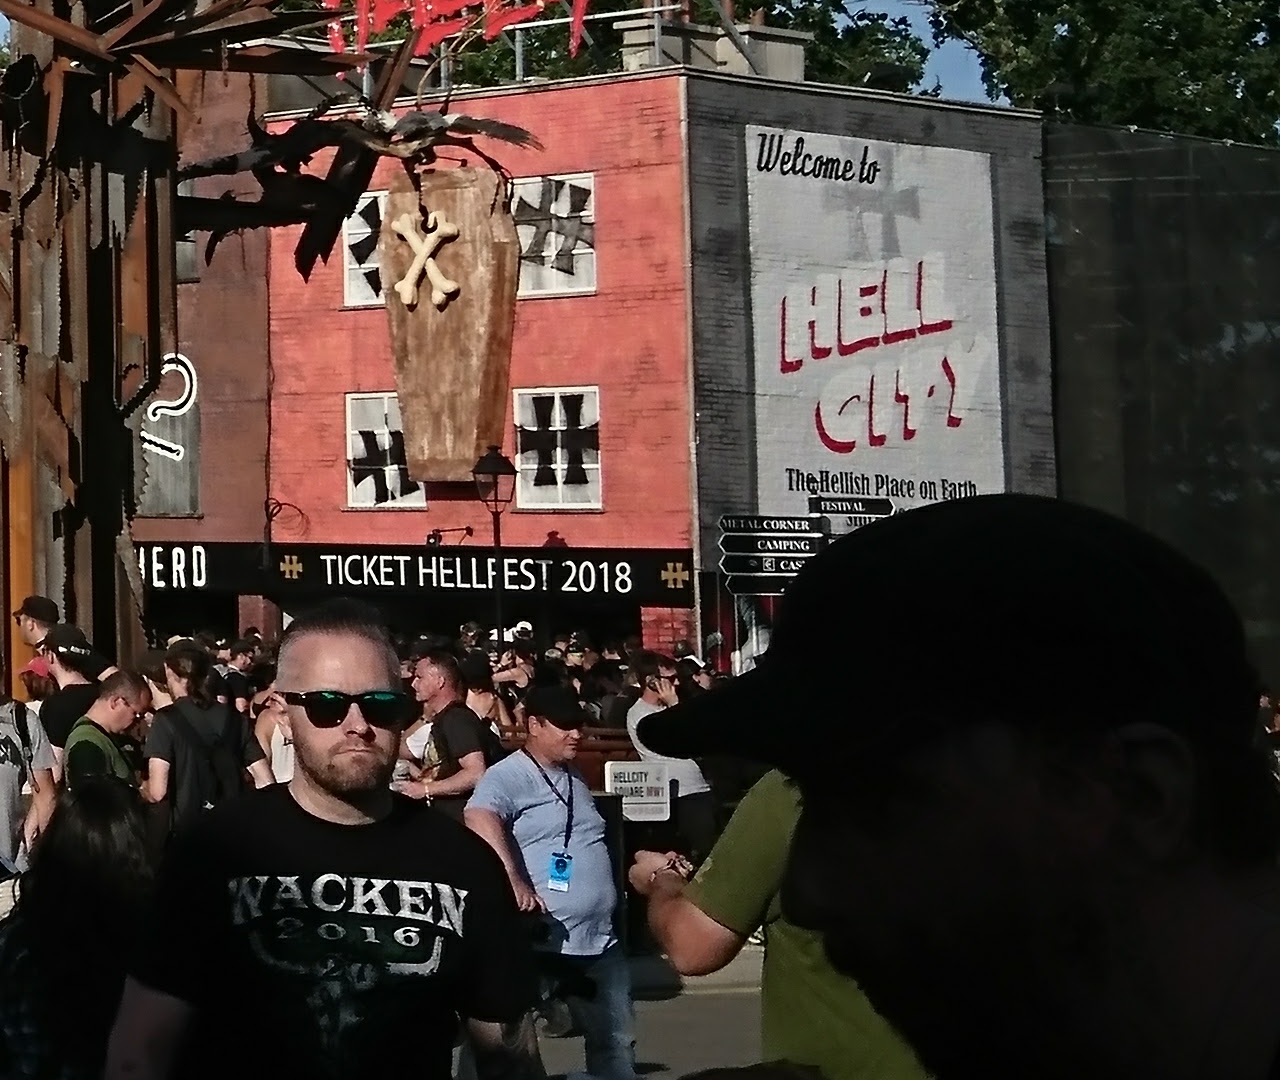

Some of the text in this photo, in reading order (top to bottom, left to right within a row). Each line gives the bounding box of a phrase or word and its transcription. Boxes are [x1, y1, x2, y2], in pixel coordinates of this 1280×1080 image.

[757, 133, 881, 184] Welcome to
[781, 254, 952, 373] HELL
[819, 470, 870, 496] Hellish
[874, 474, 915, 497] Place
[919, 479, 939, 500] on
[940, 478, 978, 500] Earth
[820, 501, 866, 512] FESTIVAL
[762, 519, 810, 530] CORNER
[757, 540, 810, 551] CAMPING
[319, 554, 633, 593] TICKET HELLFEST 2018
[227, 873, 470, 938] WACKEN
[276, 917, 421, 947] 2016
